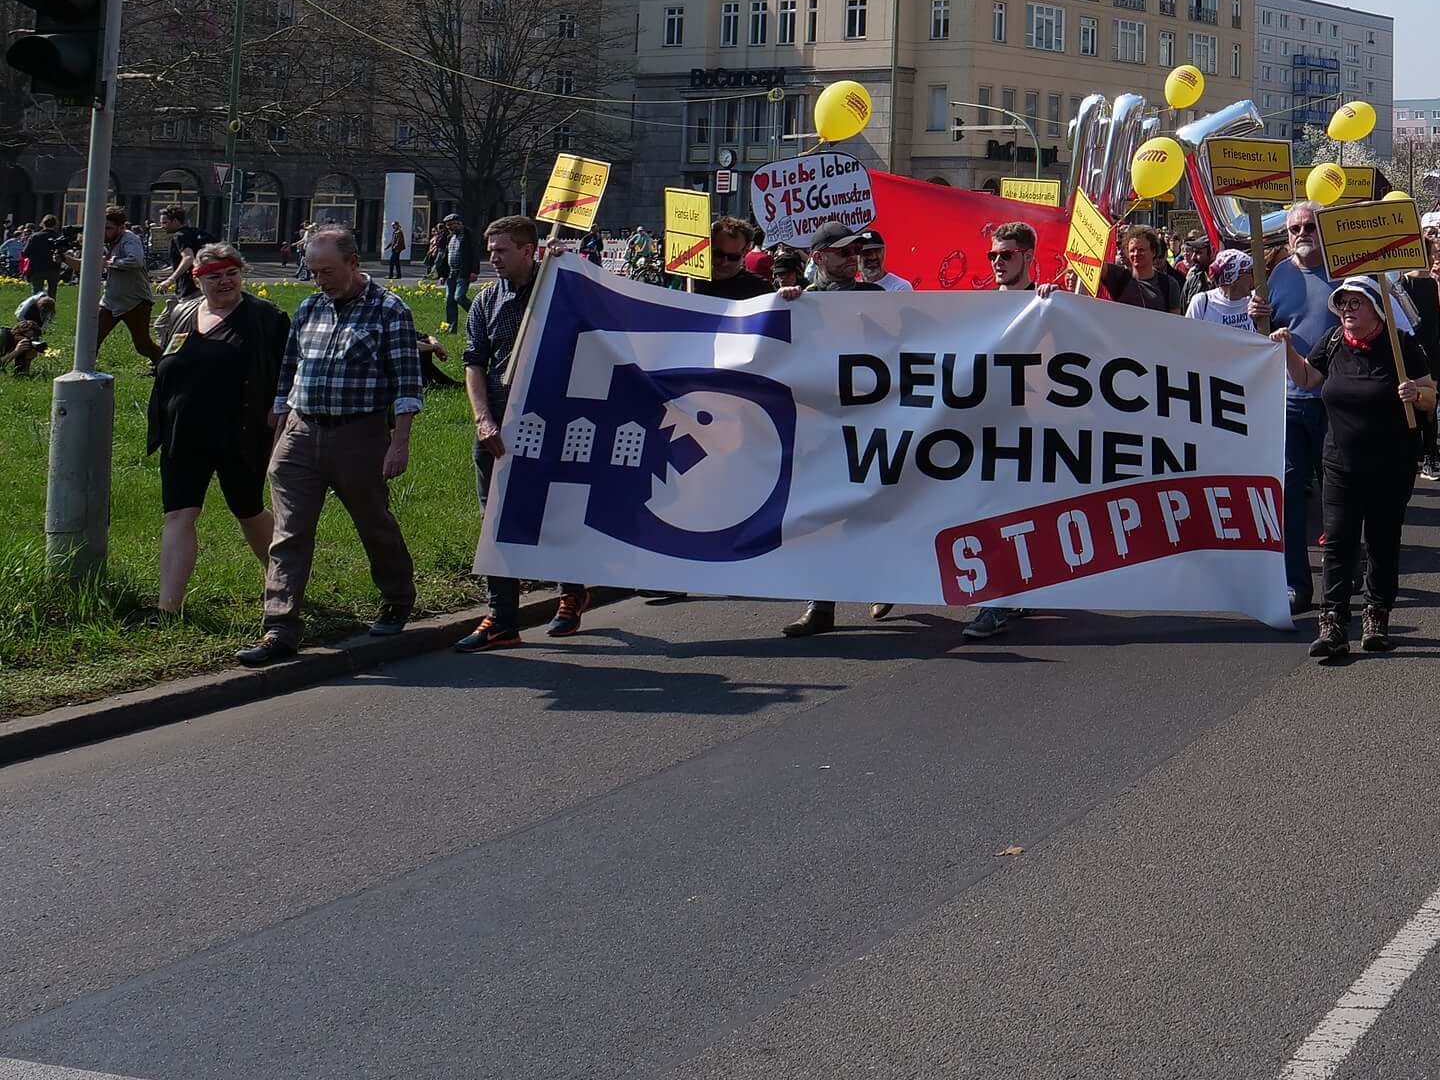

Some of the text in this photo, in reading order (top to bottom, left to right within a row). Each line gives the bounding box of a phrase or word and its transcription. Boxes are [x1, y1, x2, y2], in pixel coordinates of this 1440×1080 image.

[771, 155, 860, 189] Liebe leben
[1222, 148, 1278, 163] Friesenstr. 14
[764, 193, 777, 222] §
[806, 183, 831, 211] GG
[831, 182, 871, 206] umsetzen
[1336, 213, 1404, 233] Friesenstr. 14
[1381, 246, 1421, 260] Wohnen
[838, 352, 1249, 437] DEUTSCHE
[842, 425, 1198, 486] WOHNEN
[951, 486, 1282, 597] STOPPEN
